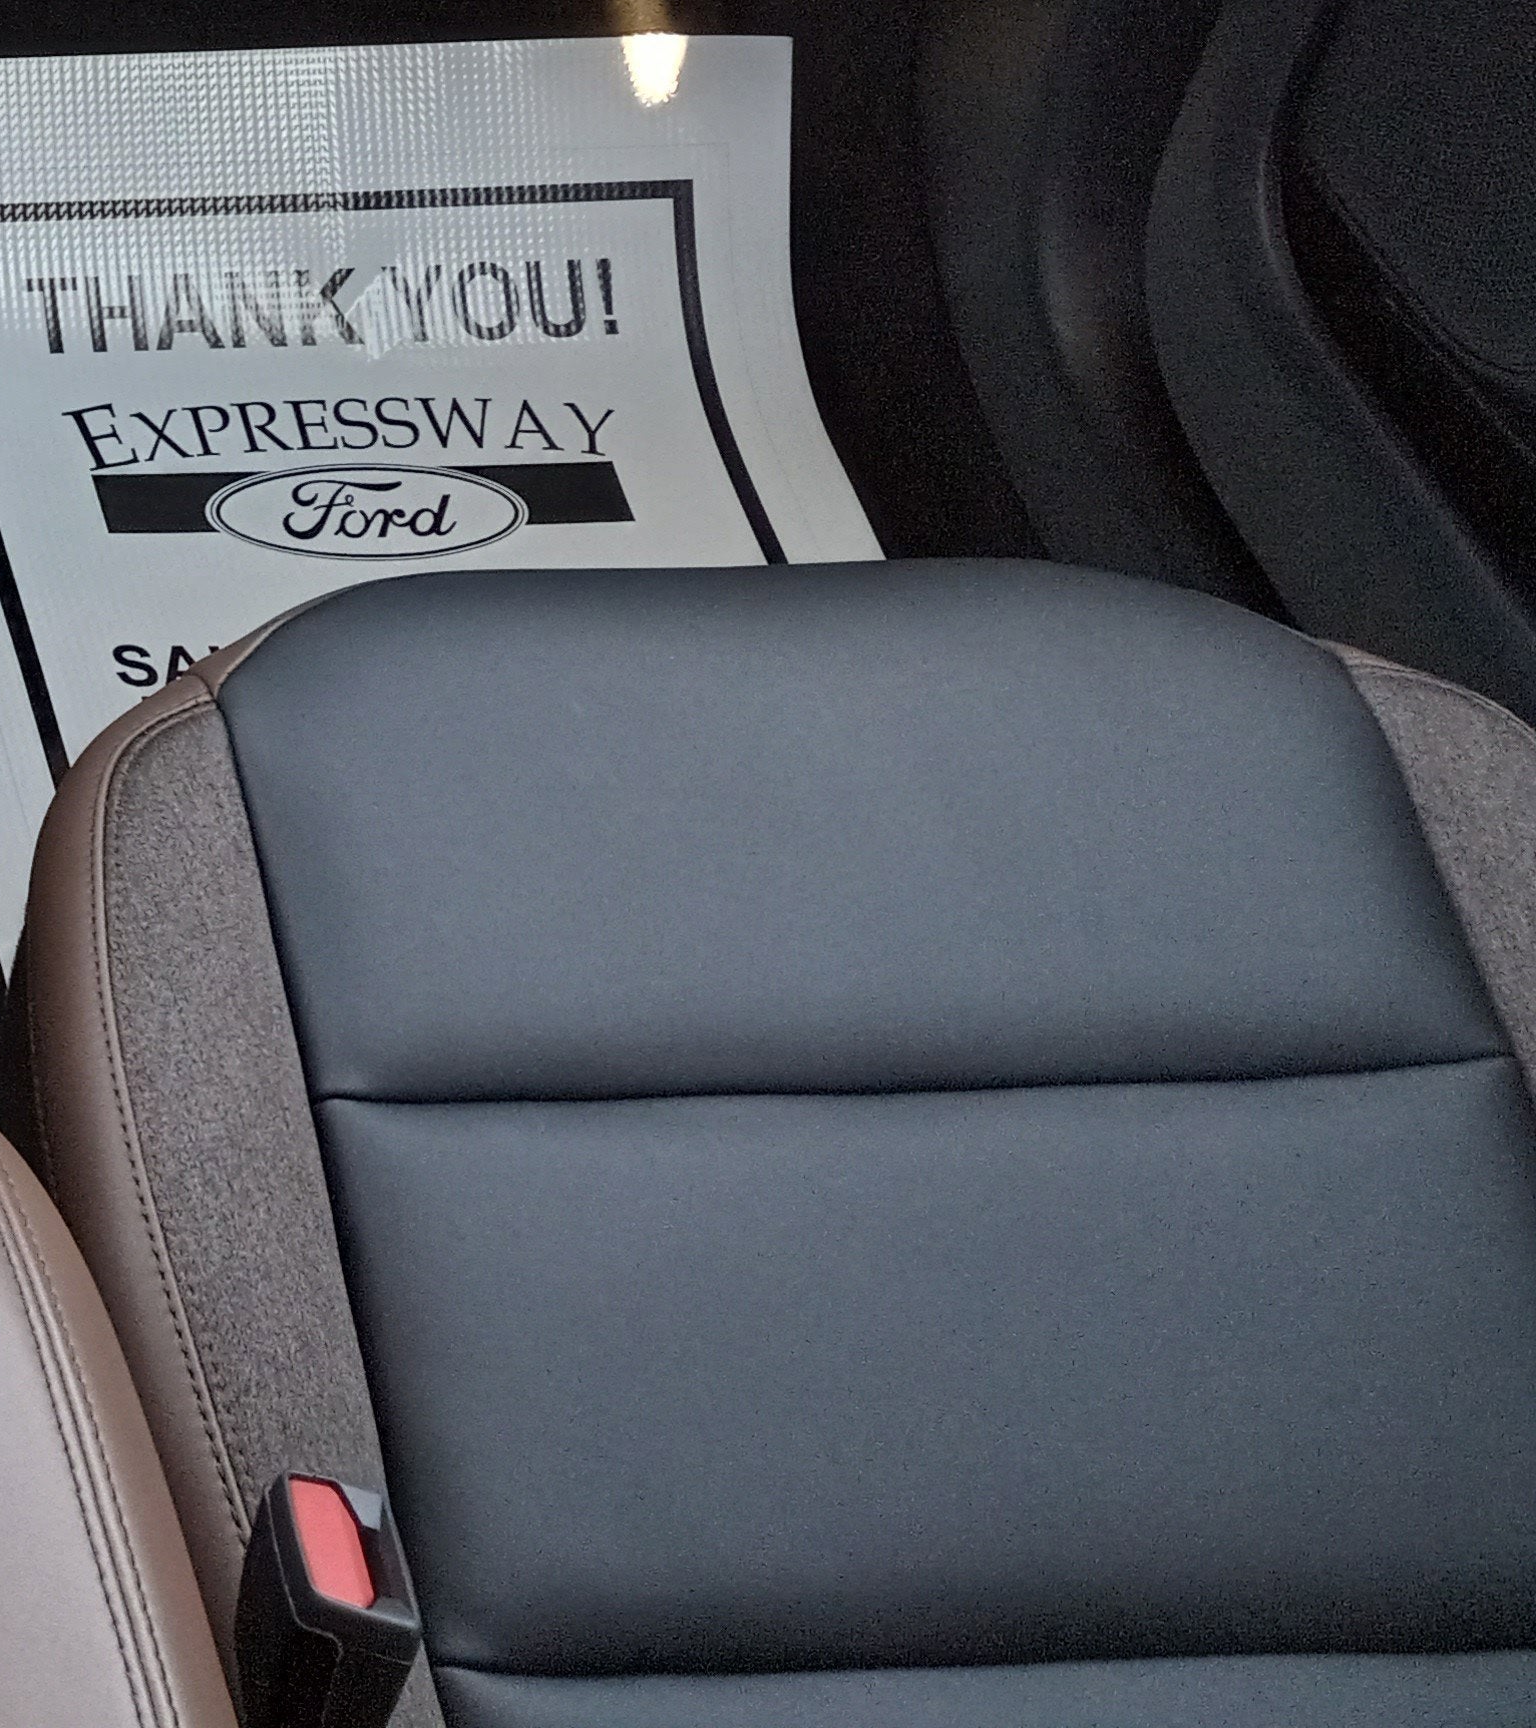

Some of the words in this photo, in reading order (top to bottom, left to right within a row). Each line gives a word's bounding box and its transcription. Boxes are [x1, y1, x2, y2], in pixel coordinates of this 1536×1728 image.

[26, 266, 365, 355] THANK
[381, 257, 620, 344] YOU!
[283, 480, 458, 540] Ford
